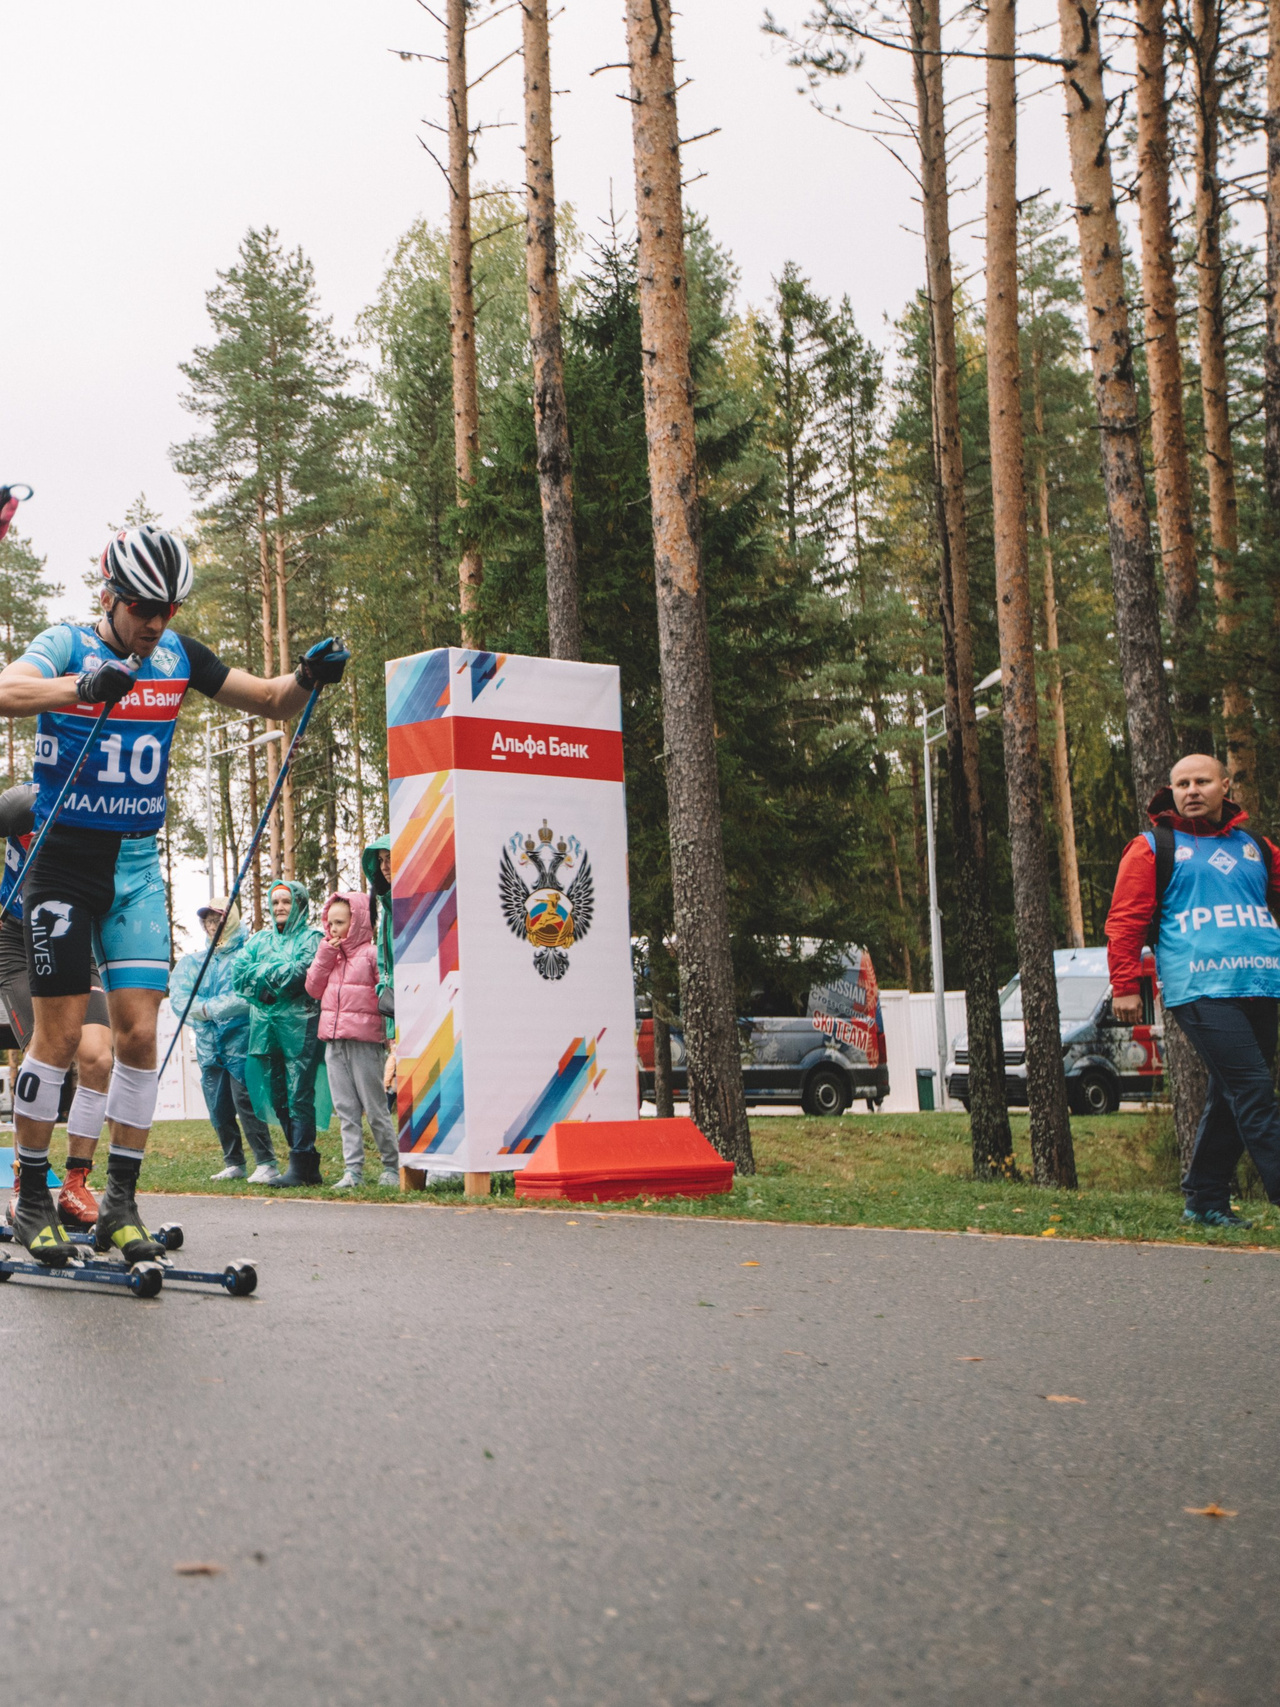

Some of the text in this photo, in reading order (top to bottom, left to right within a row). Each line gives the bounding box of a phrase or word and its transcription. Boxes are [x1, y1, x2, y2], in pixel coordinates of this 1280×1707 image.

[142, 688, 183, 707] Банк
[35, 740, 53, 758] 10
[491, 731, 589, 759] Альфа Банк
[98, 734, 161, 785] 10
[63, 792, 166, 815] МАЛИНОВК
[1175, 904, 1278, 934] ТРЕНЕ
[1190, 955, 1280, 974] МАЛИНОВК
[812, 1009, 869, 1053] SKI TEAM
